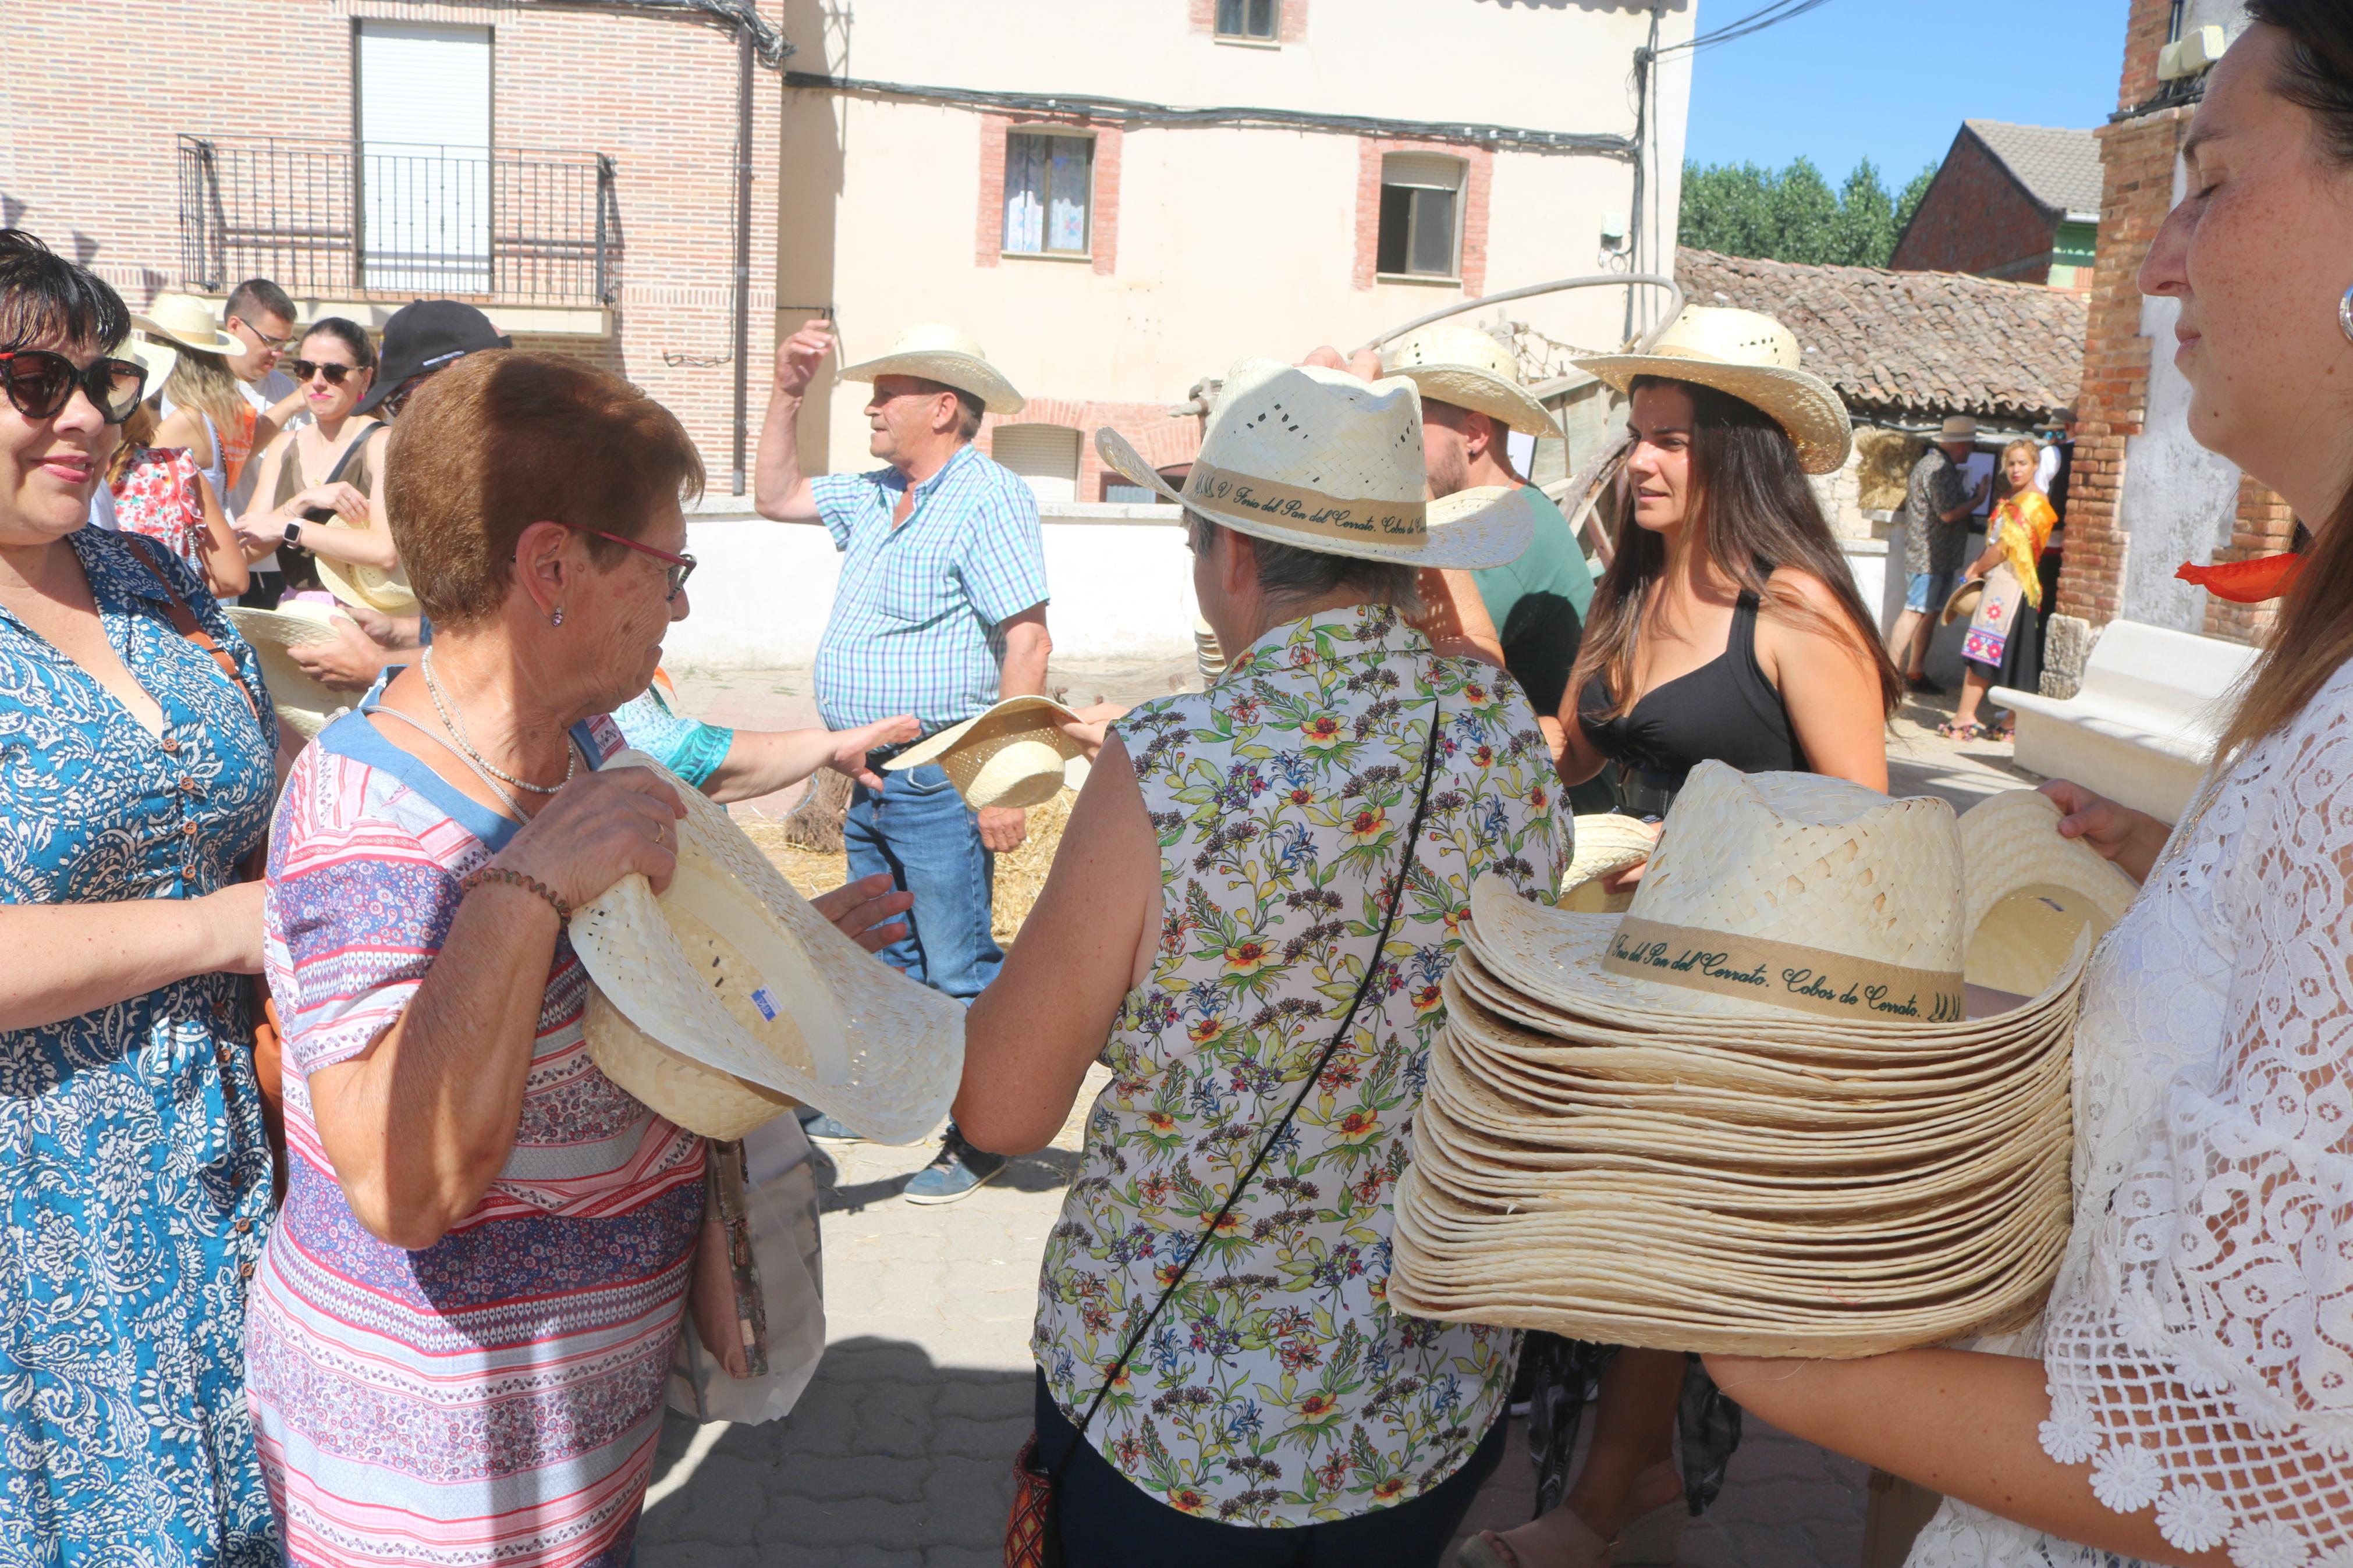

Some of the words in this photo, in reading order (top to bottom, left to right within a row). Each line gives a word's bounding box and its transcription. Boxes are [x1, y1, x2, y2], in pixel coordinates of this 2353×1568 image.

[1233, 486, 1260, 509] Feria
[1261, 497, 1284, 513] del
[1280, 500, 1307, 518] Pan
[1309, 508, 1333, 523] del
[1332, 510, 1376, 532] Cerrato.
[1382, 515, 1407, 534] Cobos
[1628, 942, 1651, 962] del
[1644, 943, 1669, 968] Pan
[1671, 950, 1702, 971] del
[1700, 953, 1769, 987] Cerrato.
[1782, 968, 1836, 1000] Cobos
[1839, 983, 1858, 1005] de
[1864, 985, 1920, 1018] Cerrato.
